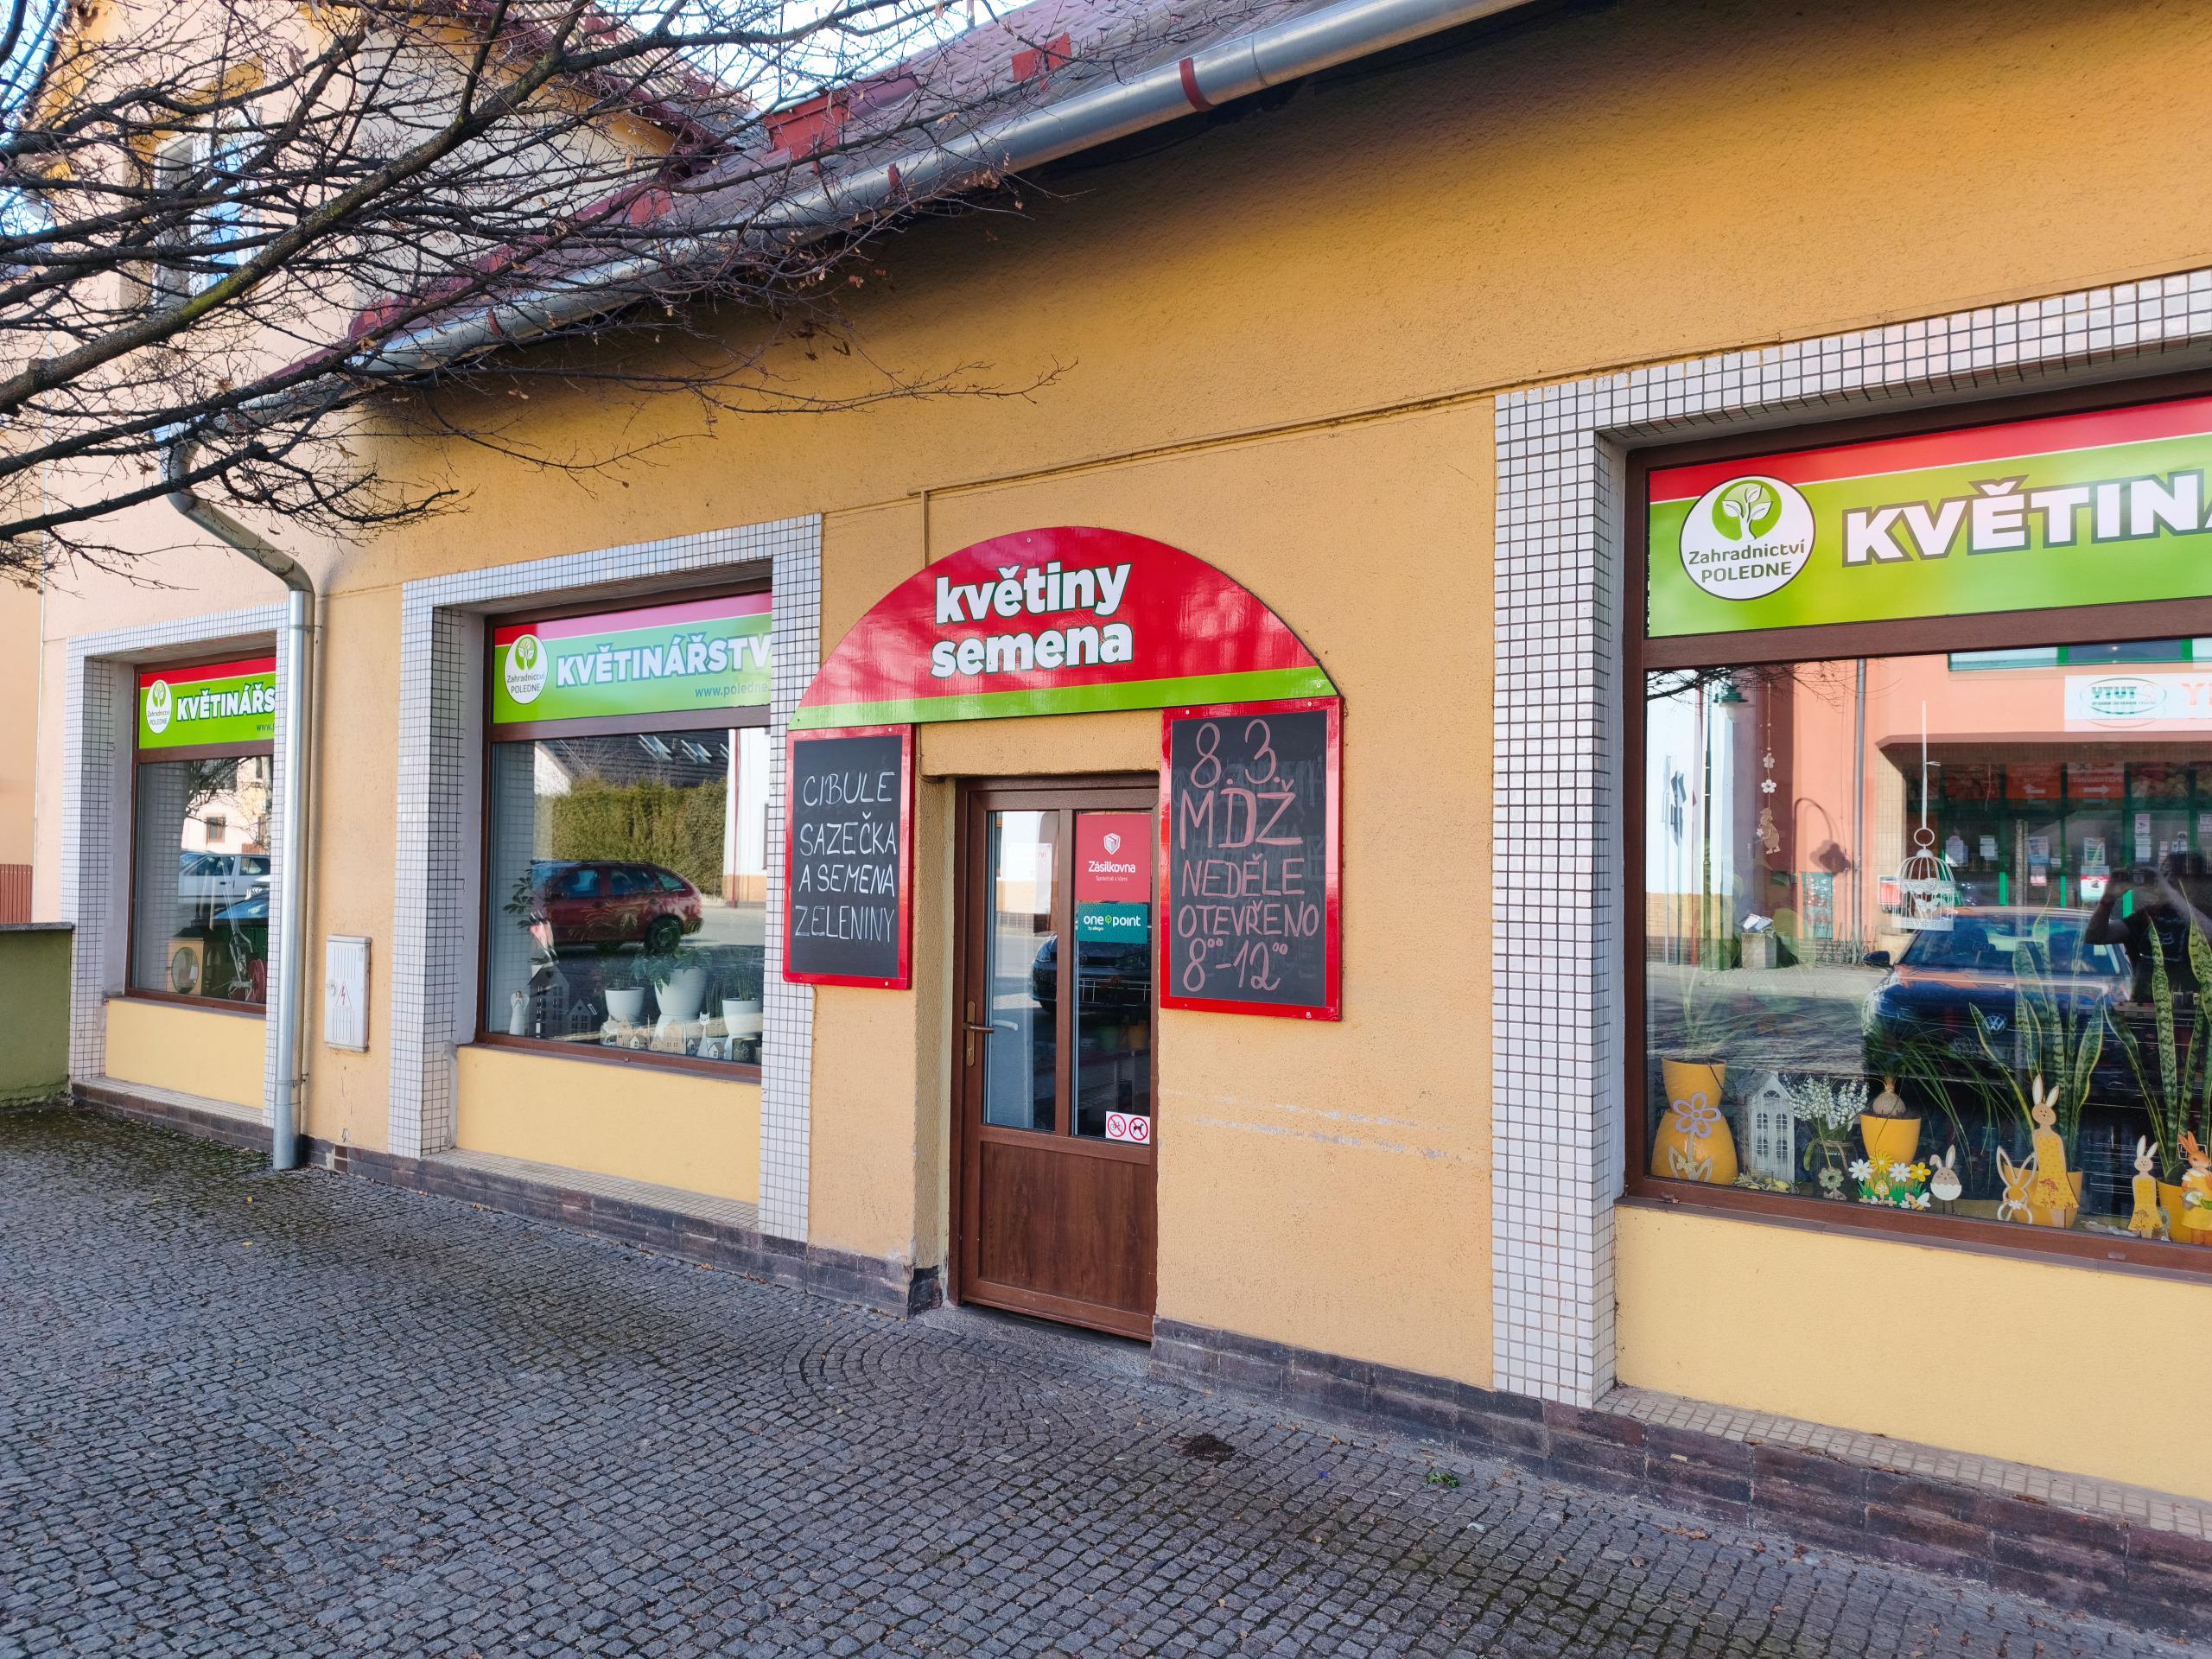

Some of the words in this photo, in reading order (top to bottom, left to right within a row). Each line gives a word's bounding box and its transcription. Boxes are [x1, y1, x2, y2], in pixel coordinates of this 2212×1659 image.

[1843, 468, 2212, 567] KVĚTIN
[1688, 538, 1805, 565] Zahradnictví
[1701, 561, 1792, 583] POLEDNE
[936, 561, 1133, 624] květiny
[556, 632, 772, 688] KVĚTINÁŘSTV
[931, 621, 1134, 678] semena
[176, 682, 275, 721] KVĚTINÁŘS
[511, 683, 541, 694] POLEDNE
[803, 772, 895, 807] CIBULE
[799, 810, 896, 857] SAZEČKA
[1179, 779, 1306, 849] MDŽ
[798, 864, 810, 893] A
[817, 864, 895, 897] SEMENA
[1088, 861, 1136, 874] Zásilkovna
[1182, 853, 1305, 899] NEDĚLE
[795, 905, 895, 943] ZELENINY
[1084, 915, 1104, 925] one
[1112, 915, 1141, 927] point
[1177, 899, 1319, 938] OTEVŘENO
